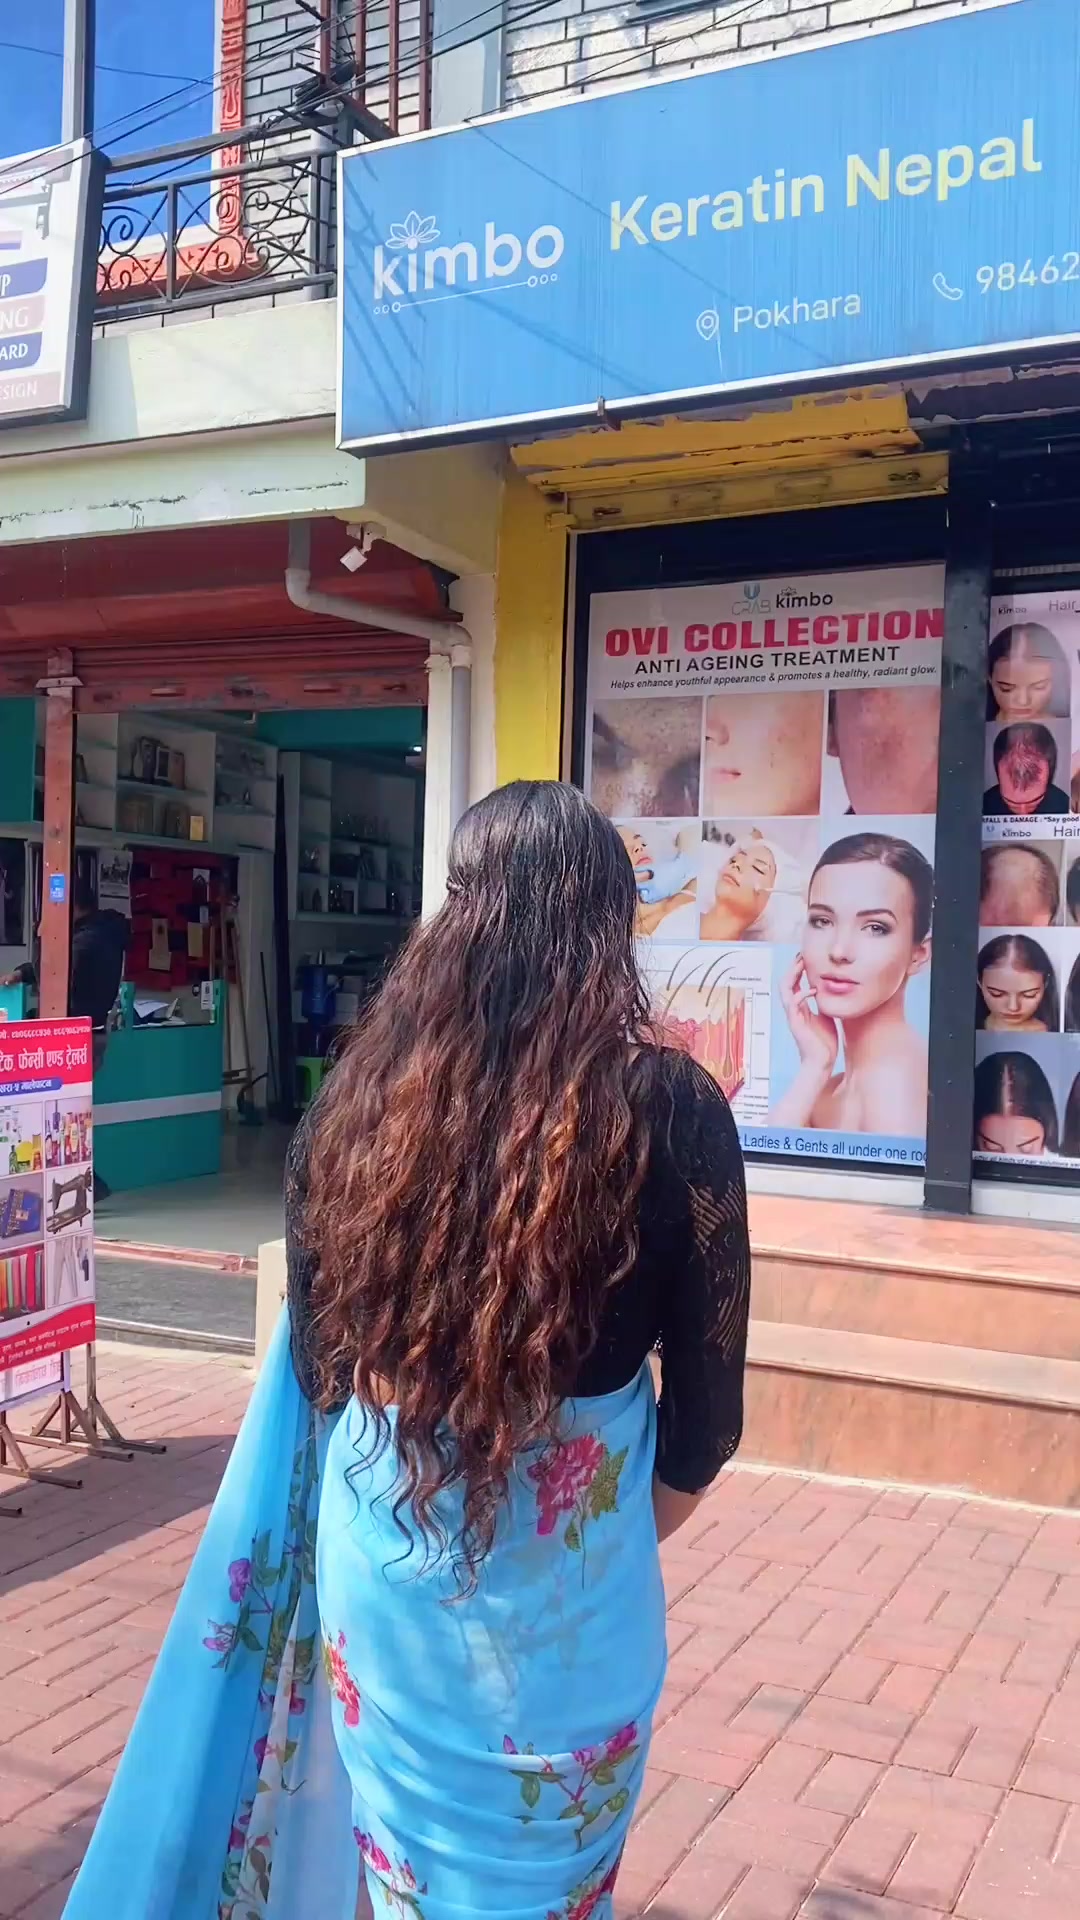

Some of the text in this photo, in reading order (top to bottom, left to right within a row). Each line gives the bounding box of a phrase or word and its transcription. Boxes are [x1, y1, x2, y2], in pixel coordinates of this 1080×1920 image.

[609, 117, 1043, 251] Keratin Nepal
[374, 221, 565, 300] kimbo
[975, 251, 1080, 294] 98462
[0, 274, 12, 297] P
[732, 289, 863, 333] Pokhara
[776, 592, 833, 608] kimbo
[605, 608, 945, 657] OVI COLLECTION
[611, 680, 635, 690] Helps
[637, 679, 673, 688] enhance
[675, 676, 712, 688] youthful
[714, 674, 766, 686] appearance
[769, 674, 776, 682] &
[778, 672, 822, 683] promotes
[833, 668, 871, 679] healthy,
[873, 667, 908, 677] radiant
[911, 664, 936, 676] glow.
[635, 646, 901, 675] ANTI AGEING TREATMENT
[744, 1133, 780, 1150] Ladies
[783, 1137, 791, 1150] &
[795, 1138, 828, 1154] Gents
[832, 1142, 845, 1155] all
[849, 1143, 882, 1158] under
[885, 1147, 908, 1160] one
